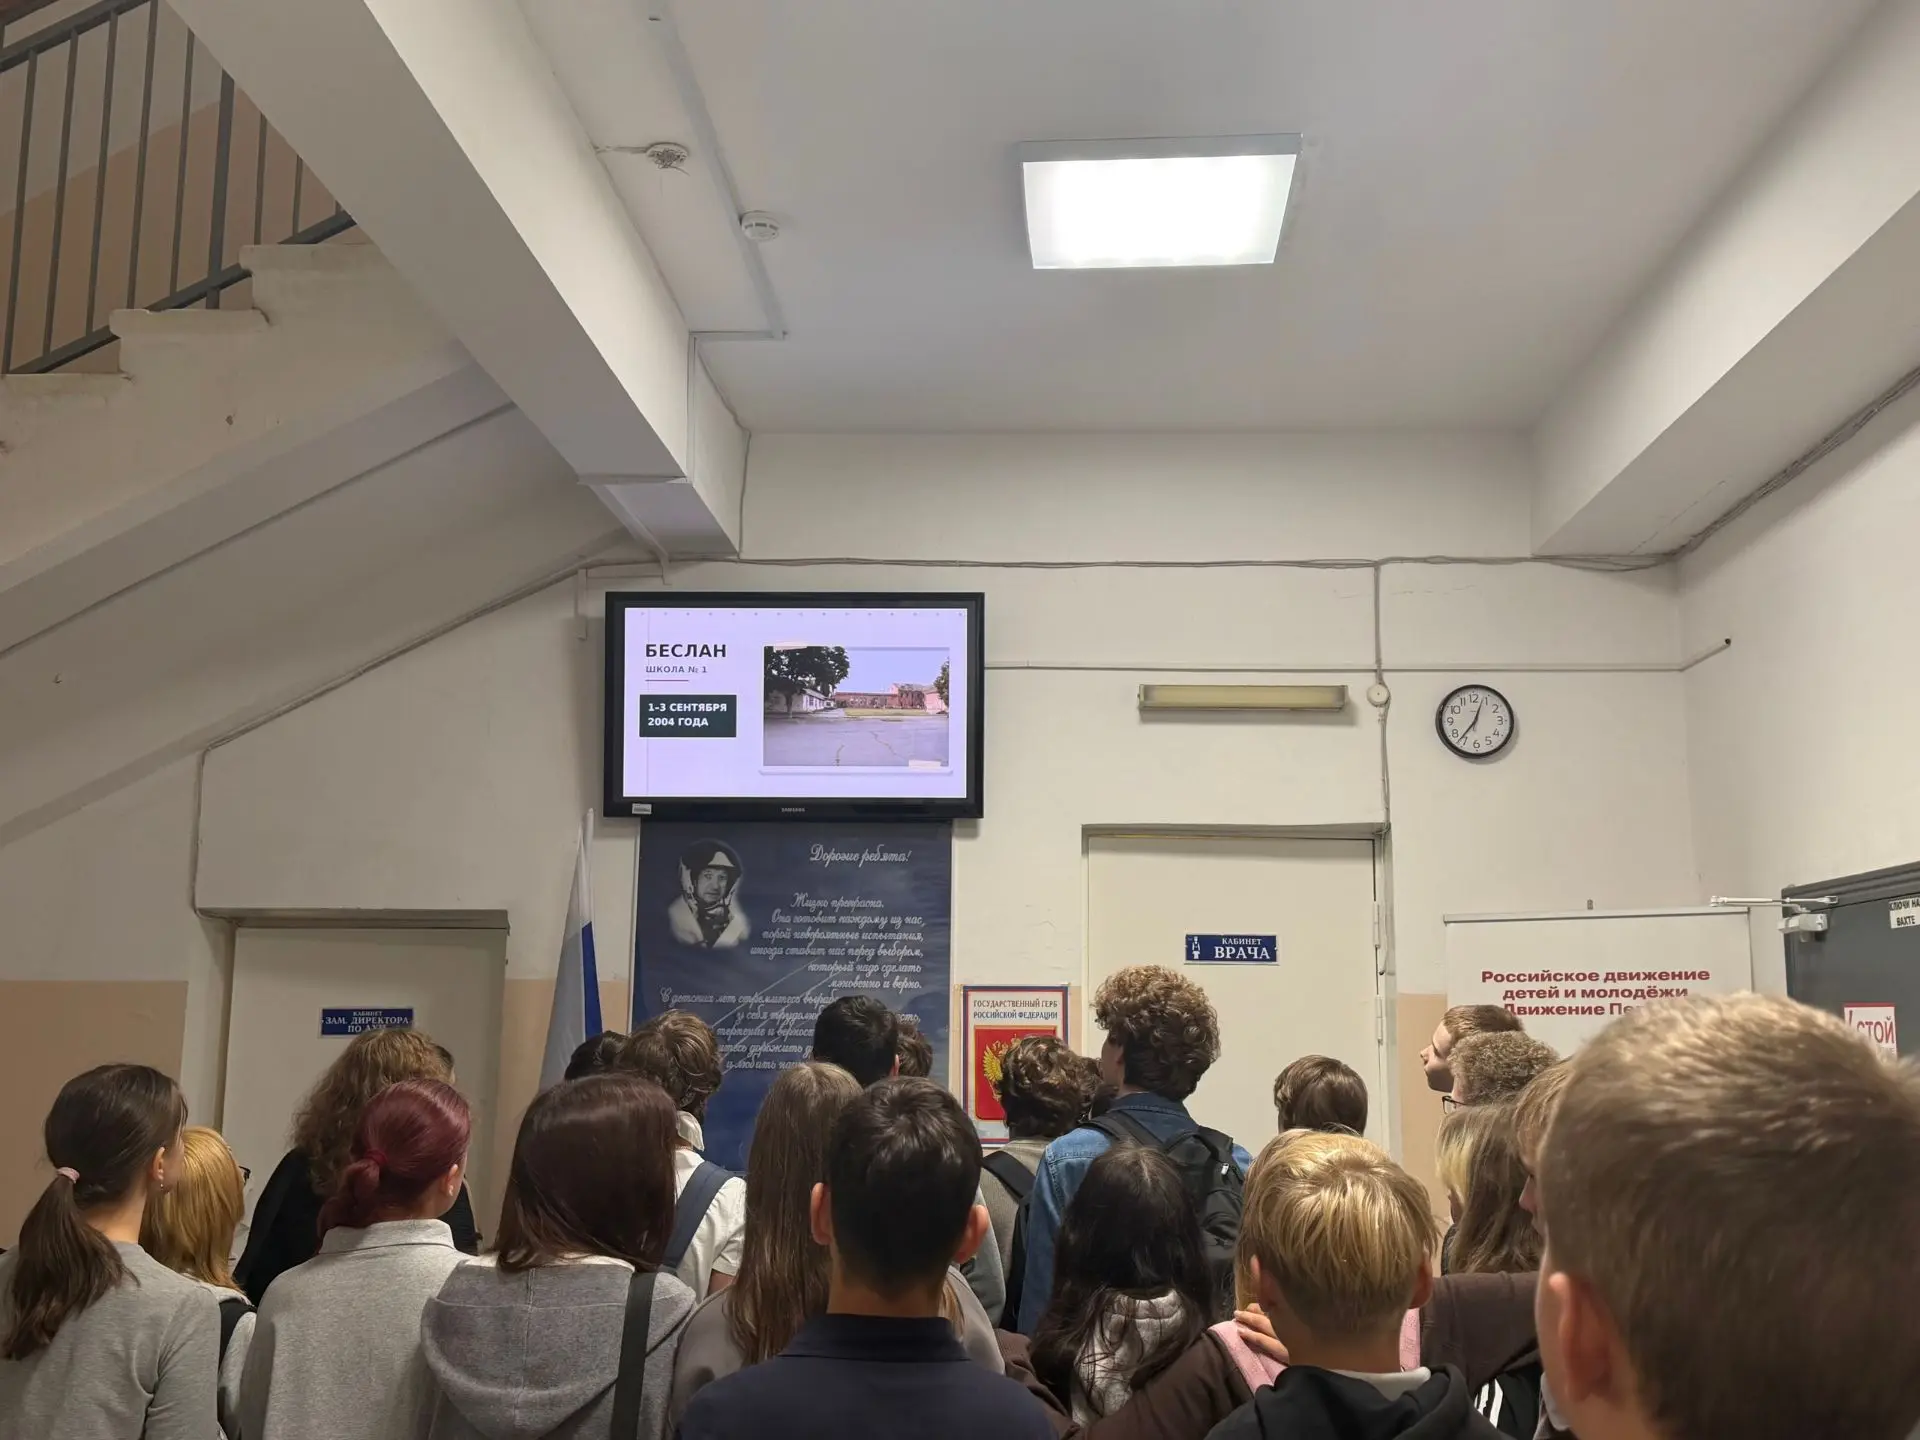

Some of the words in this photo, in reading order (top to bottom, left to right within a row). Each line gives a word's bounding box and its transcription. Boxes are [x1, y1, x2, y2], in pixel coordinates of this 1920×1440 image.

[645, 643, 727, 658] БЕСЛАН
[645, 665, 685, 673] ШКОЛА
[688, 665, 699, 674] №
[702, 665, 708, 673] 1
[1469, 694, 1479, 704] 12
[669, 702, 728, 712] СЕНТЯБРЯ
[1450, 705, 1460, 714] 10
[1492, 704, 1499, 713] 2
[647, 717, 675, 727] 2004
[678, 717, 709, 728] ГОДА
[1447, 717, 1454, 725] 9
[1497, 716, 1504, 725] 3
[1451, 729, 1459, 738] 8
[1492, 728, 1500, 737] 4
[1473, 740, 1480, 748] 6
[1485, 736, 1492, 745] 5
[810, 844, 860, 867] Дорогие
[859, 844, 912, 867] ребята!
[790, 892, 829, 912] Жизнь
[831, 897, 884, 912] прекрасна.
[771, 909, 791, 923] Она
[793, 911, 836, 924] готовит
[838, 916, 888, 929] каждому
[890, 916, 902, 929] из
[904, 916, 926, 927] нас,
[1896, 915, 1916, 927] ВАХТЕ
[762, 928, 791, 943] порой
[793, 926, 860, 942] невероятные
[847, 947, 875, 960] перед
[1214, 946, 1270, 959] ВРАЧА
[808, 961, 854, 976] который
[856, 963, 879, 977] надо
[881, 963, 922, 976] сделать
[1482, 970, 1600, 983] Российское
[1603, 970, 1711, 983] движение
[892, 976, 923, 993] верно.
[1503, 986, 1560, 1001] детей
[1564, 989, 1576, 998] и
[1581, 985, 1688, 1000] молодёжи
[973, 998, 1040, 1008] ГОСУДАРСТВЕННЫЙ
[1041, 1000, 1058, 1008] ГЕРБ
[973, 1009, 1017, 1019] РОССИЙСКОЙ
[1018, 1011, 1058, 1020] ФЕДЕРАЦИИ
[325, 1017, 348, 1025] ЗАМ.
[350, 1016, 409, 1025] ДИРЕКТОРА
[347, 1025, 362, 1033] ПО
[767, 1028, 775, 1036] и
